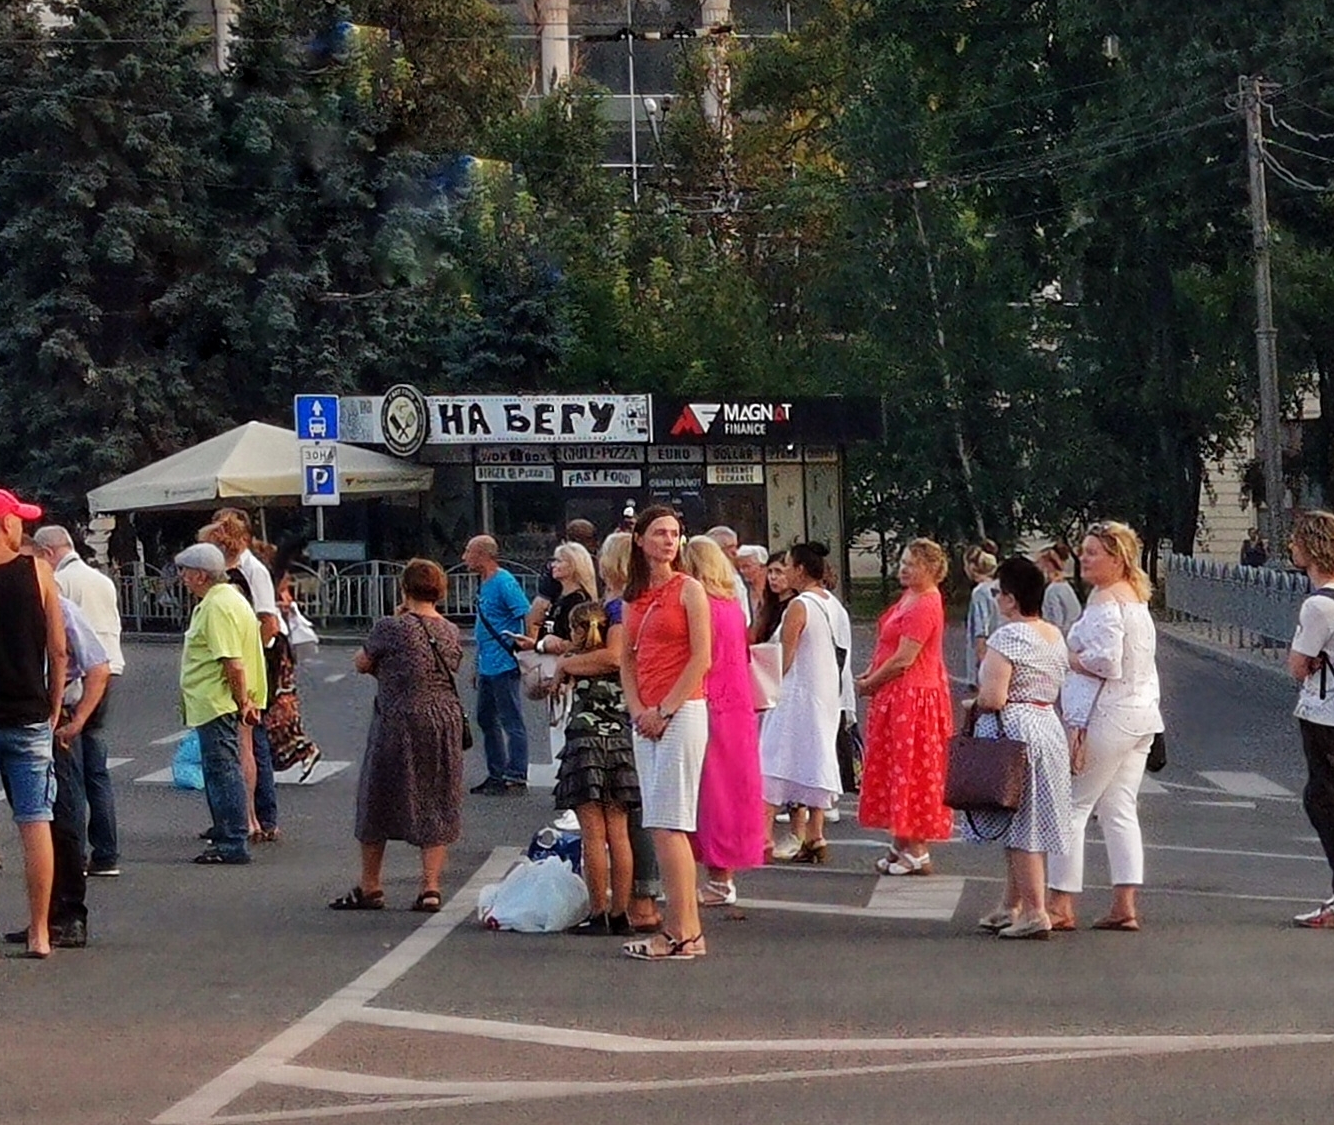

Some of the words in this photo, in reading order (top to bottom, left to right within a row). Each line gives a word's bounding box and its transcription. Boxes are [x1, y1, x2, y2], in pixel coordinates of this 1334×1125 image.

[438, 403, 491, 435] НА
[503, 401, 615, 435] БЕГУ
[724, 404, 793, 422] MAGNAT
[725, 423, 766, 436] FINANCE
[658, 449, 691, 460] EURO
[312, 468, 329, 492] P
[568, 472, 599, 486] FAST
